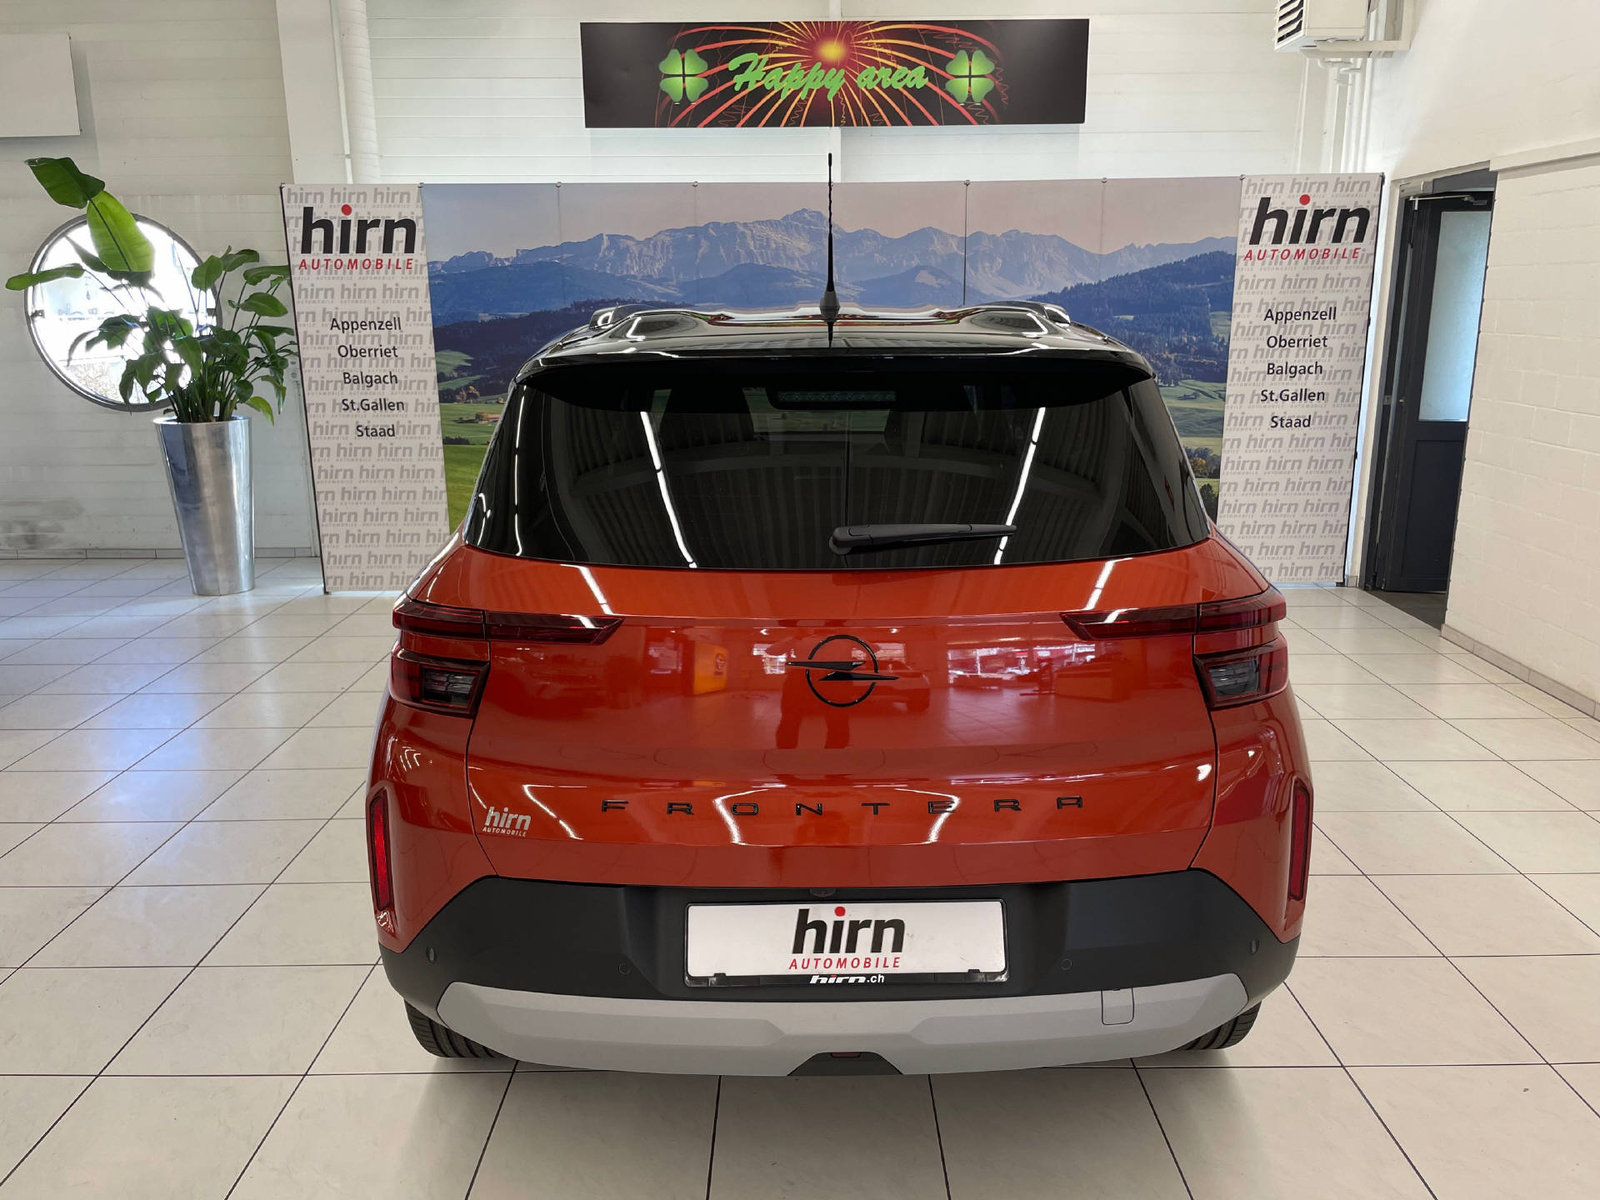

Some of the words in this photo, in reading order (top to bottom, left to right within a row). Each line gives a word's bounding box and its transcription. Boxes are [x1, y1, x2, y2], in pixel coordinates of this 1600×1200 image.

[728, 52, 846, 100] Happy
[857, 65, 929, 90] area
[1249, 194, 1370, 245] hirn
[301, 204, 416, 254] hirn
[1243, 247, 1361, 260] AUTOMOBILE
[298, 258, 413, 270] AUTOMOBILE
[1263, 306, 1336, 324] Appenzell
[330, 317, 401, 334] Appenzell
[1266, 334, 1328, 348] Oberriet
[337, 344, 399, 358] Oberriet
[1266, 361, 1323, 378] Balgach
[343, 371, 398, 388] Balgach
[1260, 388, 1325, 402] St.Gallen
[341, 397, 404, 412] St.Gallen
[1270, 414, 1311, 428] Staad
[355, 424, 395, 438] Staad
[601, 796, 1083, 816] FRONTERA
[486, 806, 532, 831] hirn
[482, 826, 527, 838] AUTOMOBILE
[791, 906, 906, 954] hirn
[788, 956, 901, 971] AUTOMOBILE
[809, 973, 885, 984] hirn.ch
